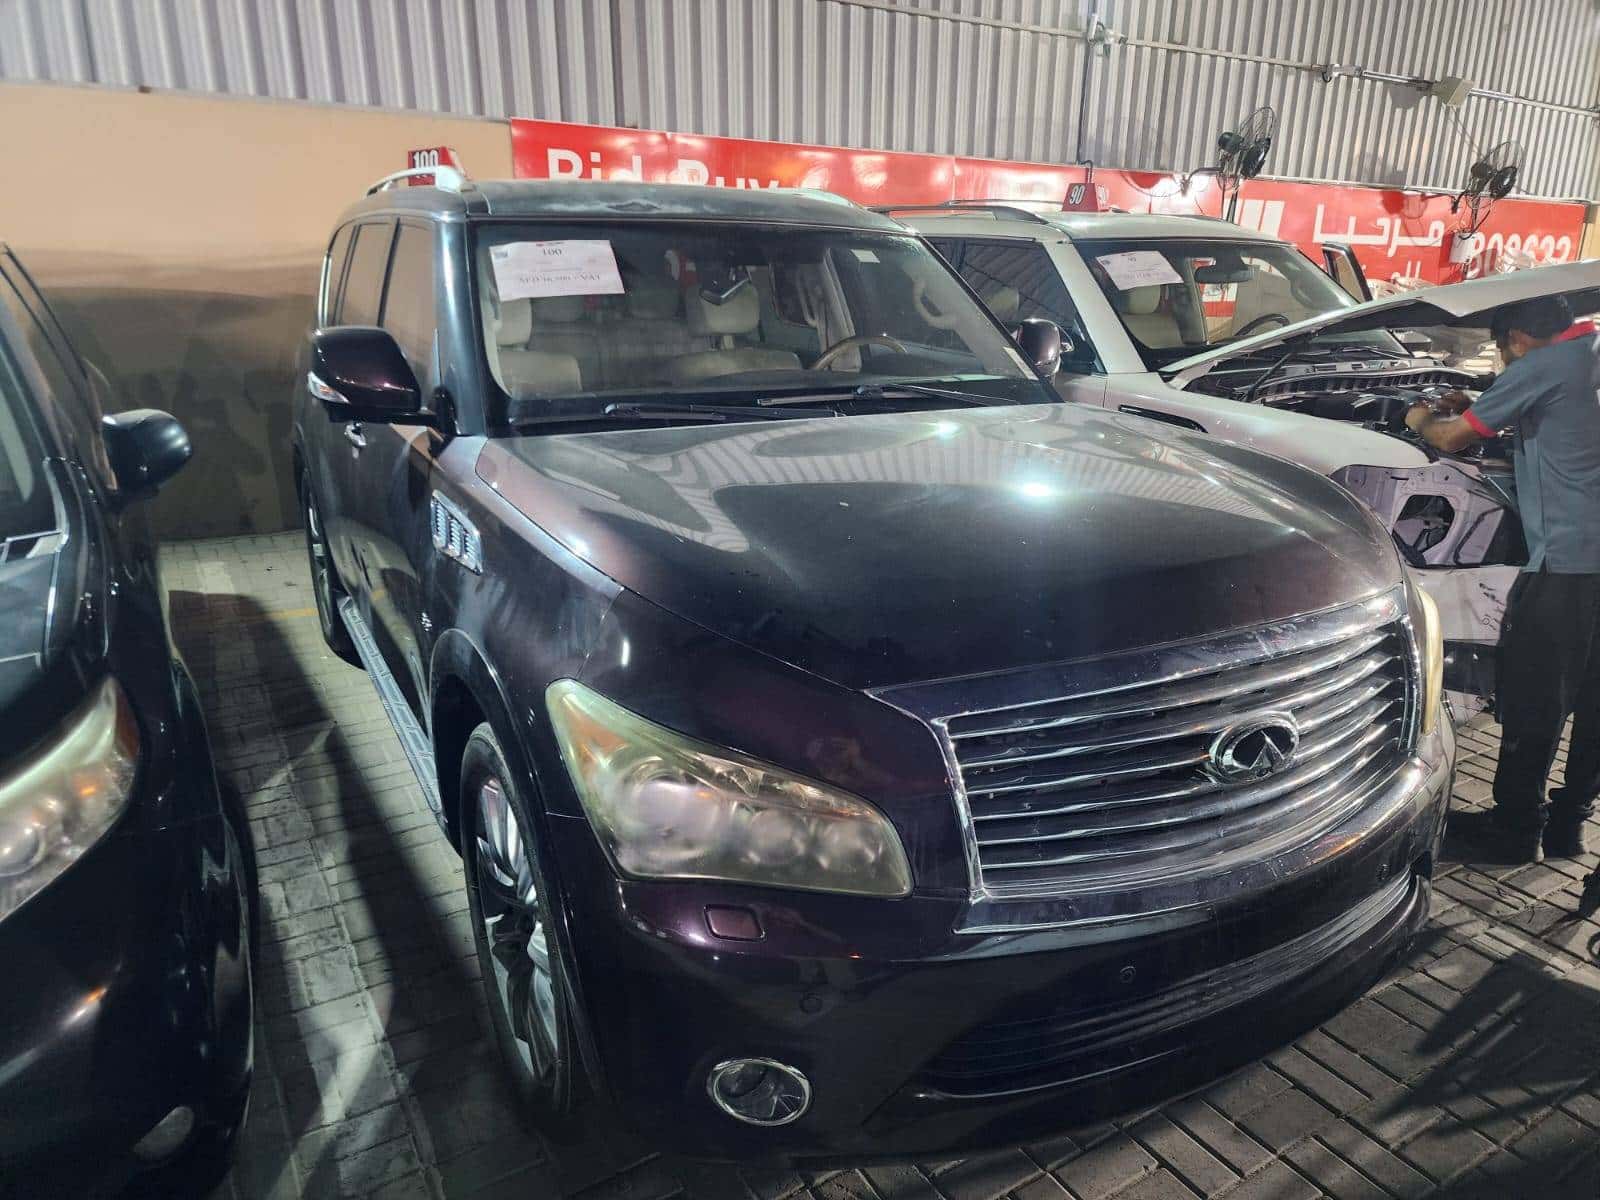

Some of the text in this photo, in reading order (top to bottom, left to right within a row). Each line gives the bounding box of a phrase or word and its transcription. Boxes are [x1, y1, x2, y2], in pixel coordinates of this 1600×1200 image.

[413, 150, 438, 168] 100
[1070, 185, 1085, 205] 90
[1312, 204, 1445, 258] مرحبا
